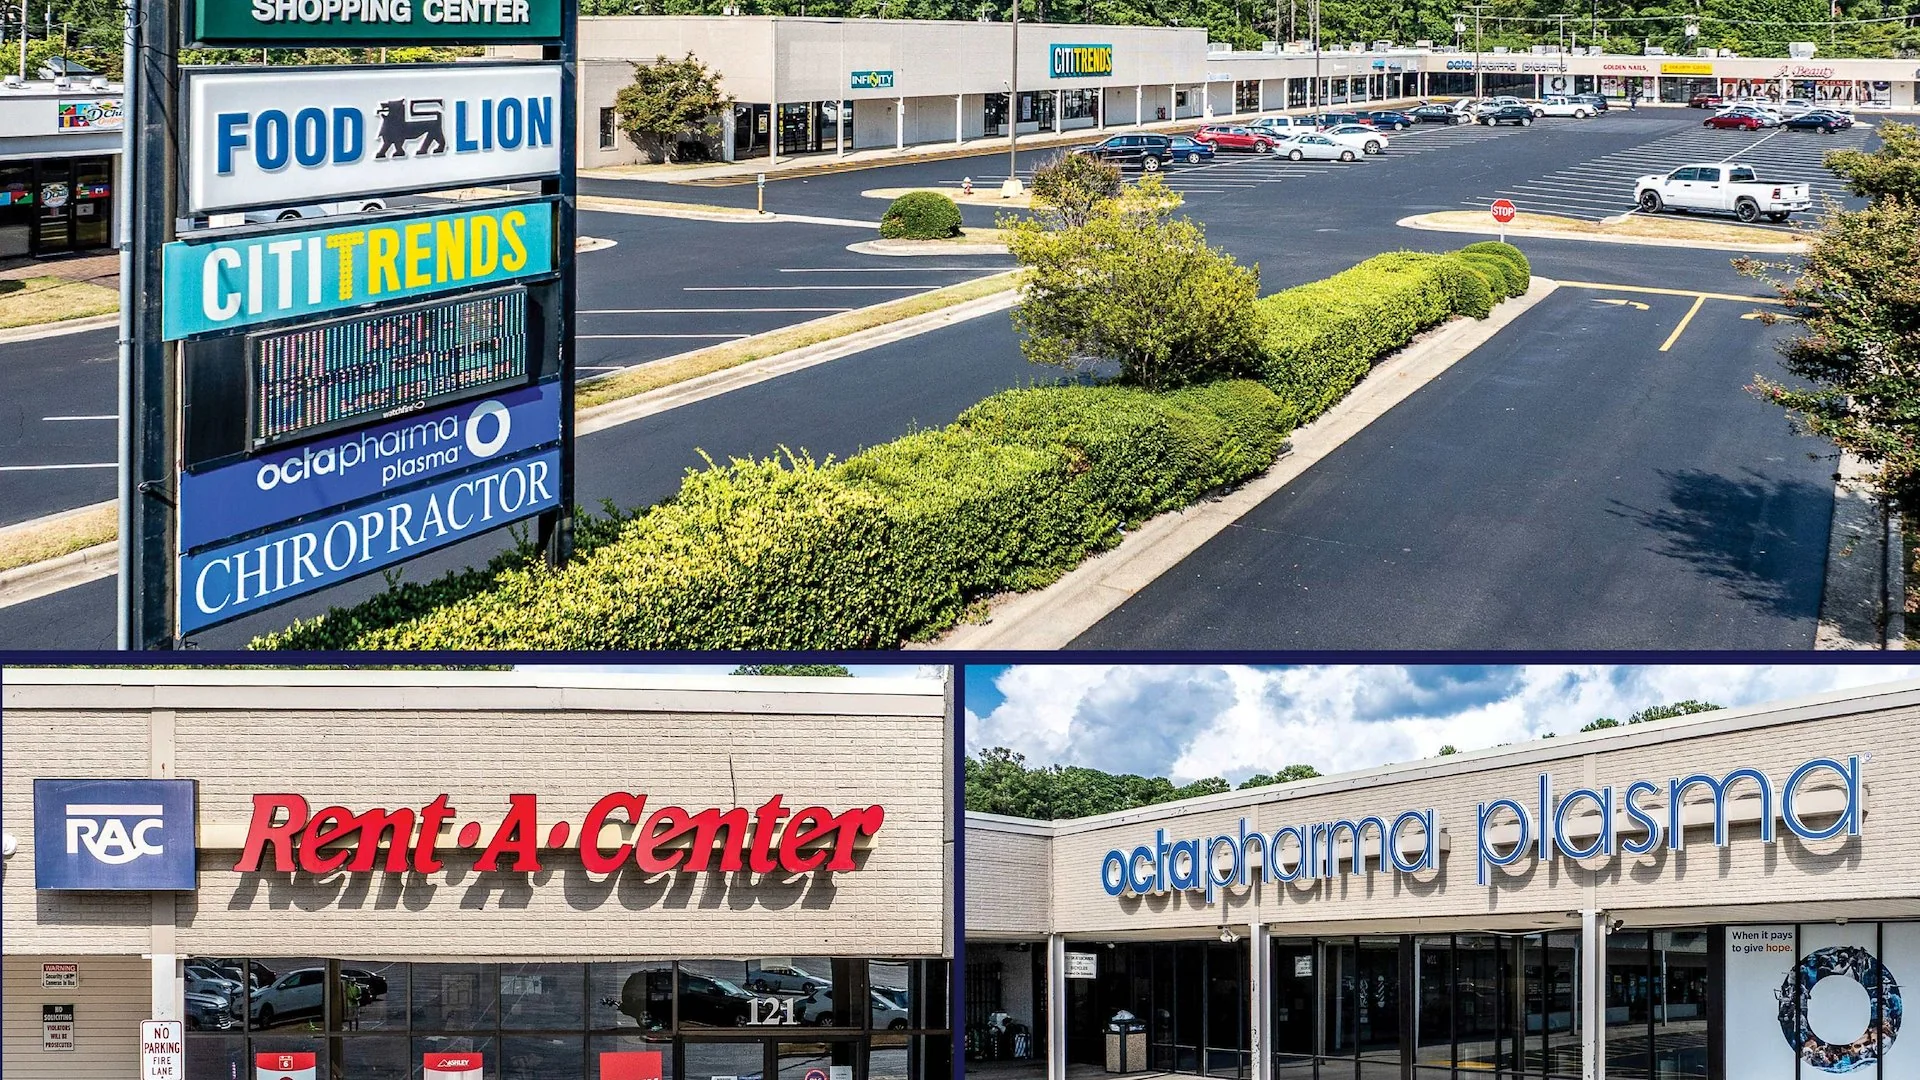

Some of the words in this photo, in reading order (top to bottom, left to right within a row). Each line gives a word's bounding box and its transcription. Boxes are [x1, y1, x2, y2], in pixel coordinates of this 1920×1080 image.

[251, 0, 412, 22] SHOPPING
[423, 0, 530, 23] CENTER
[1054, 47, 1112, 73] CITITRENDS
[1794, 65, 1833, 77] Beauty
[217, 106, 364, 175] FOOD
[456, 97, 553, 153] LION
[1493, 206, 1514, 216] STOP
[202, 210, 528, 322] CITITRENDS
[382, 404, 414, 418] watchfire
[256, 414, 459, 491] octapharma
[382, 445, 459, 487] plasma
[196, 460, 553, 615] CHIROPRACTOR
[1101, 808, 1440, 904] octapharma
[1476, 753, 1863, 886] plasma
[66, 818, 164, 864] RAC
[1732, 931, 1759, 940] When
[1761, 931, 1769, 939] it
[1771, 932, 1793, 941] pays
[1732, 944, 1742, 952] to
[1744, 943, 1764, 954] give
[1766, 943, 1793, 953] hope.
[746, 997, 799, 1025] 121
[154, 1028, 169, 1039] NO
[144, 1042, 180, 1054] PARKING
[152, 1067, 173, 1076] LANE
[153, 1057, 171, 1065] FIRE
